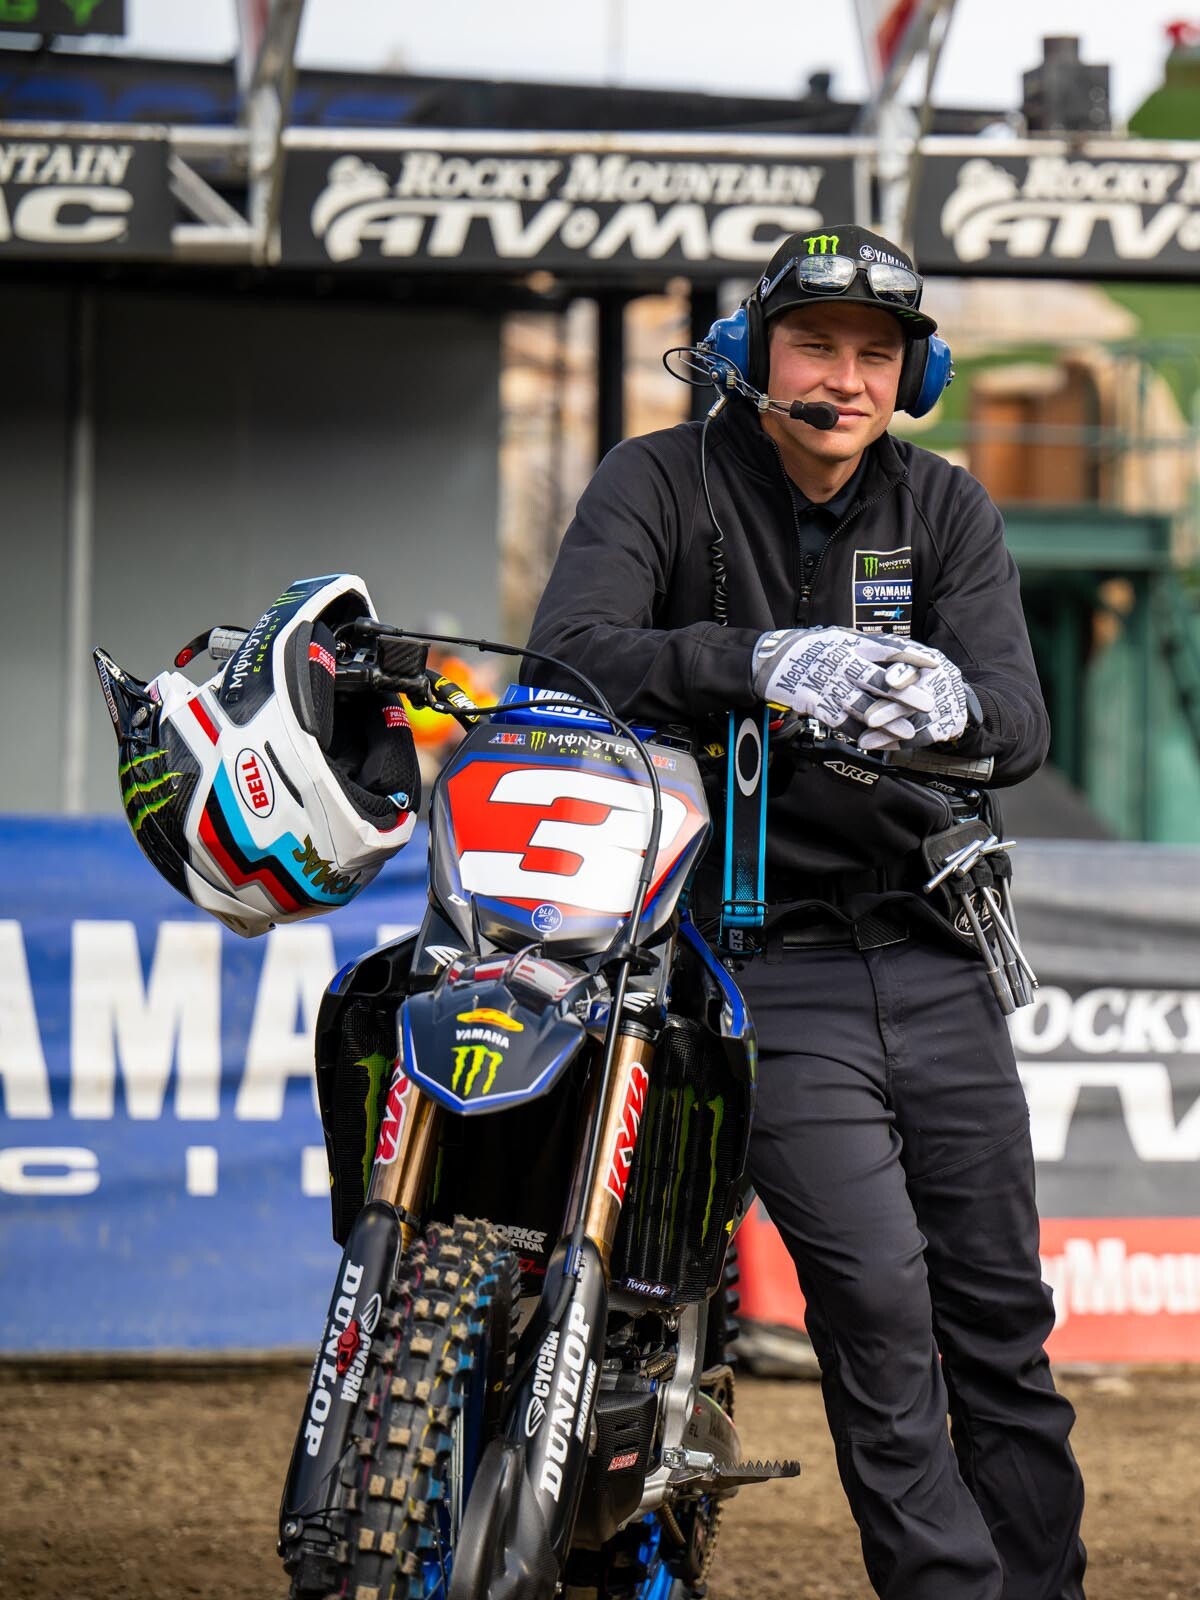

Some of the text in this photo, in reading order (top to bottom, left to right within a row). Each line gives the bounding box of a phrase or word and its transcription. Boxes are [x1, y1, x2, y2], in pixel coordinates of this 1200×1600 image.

[398, 151, 824, 206] ROCKY MOUNTAIN
[1022, 156, 1181, 203] ROCKY
[874, 585, 911, 597] YAMAHA
[229, 606, 277, 690] MONSTER
[252, 615, 281, 674] ENERGY
[776, 640, 830, 695] Mechanix
[488, 732, 527, 745] AMA
[548, 733, 638, 759] MONSTER
[559, 748, 623, 764] ENERGY
[243, 755, 270, 811] BELL
[823, 760, 880, 785] ARC
[459, 768, 689, 913] 3
[456, 1029, 509, 1049] YAMAHA
[491, 1224, 548, 1243] ORKS
[626, 1277, 669, 1297] Twin Air
[306, 1259, 364, 1457] DUNLOP
[533, 1331, 560, 1398] CYCRA
[540, 1302, 591, 1502] DUNLOP
